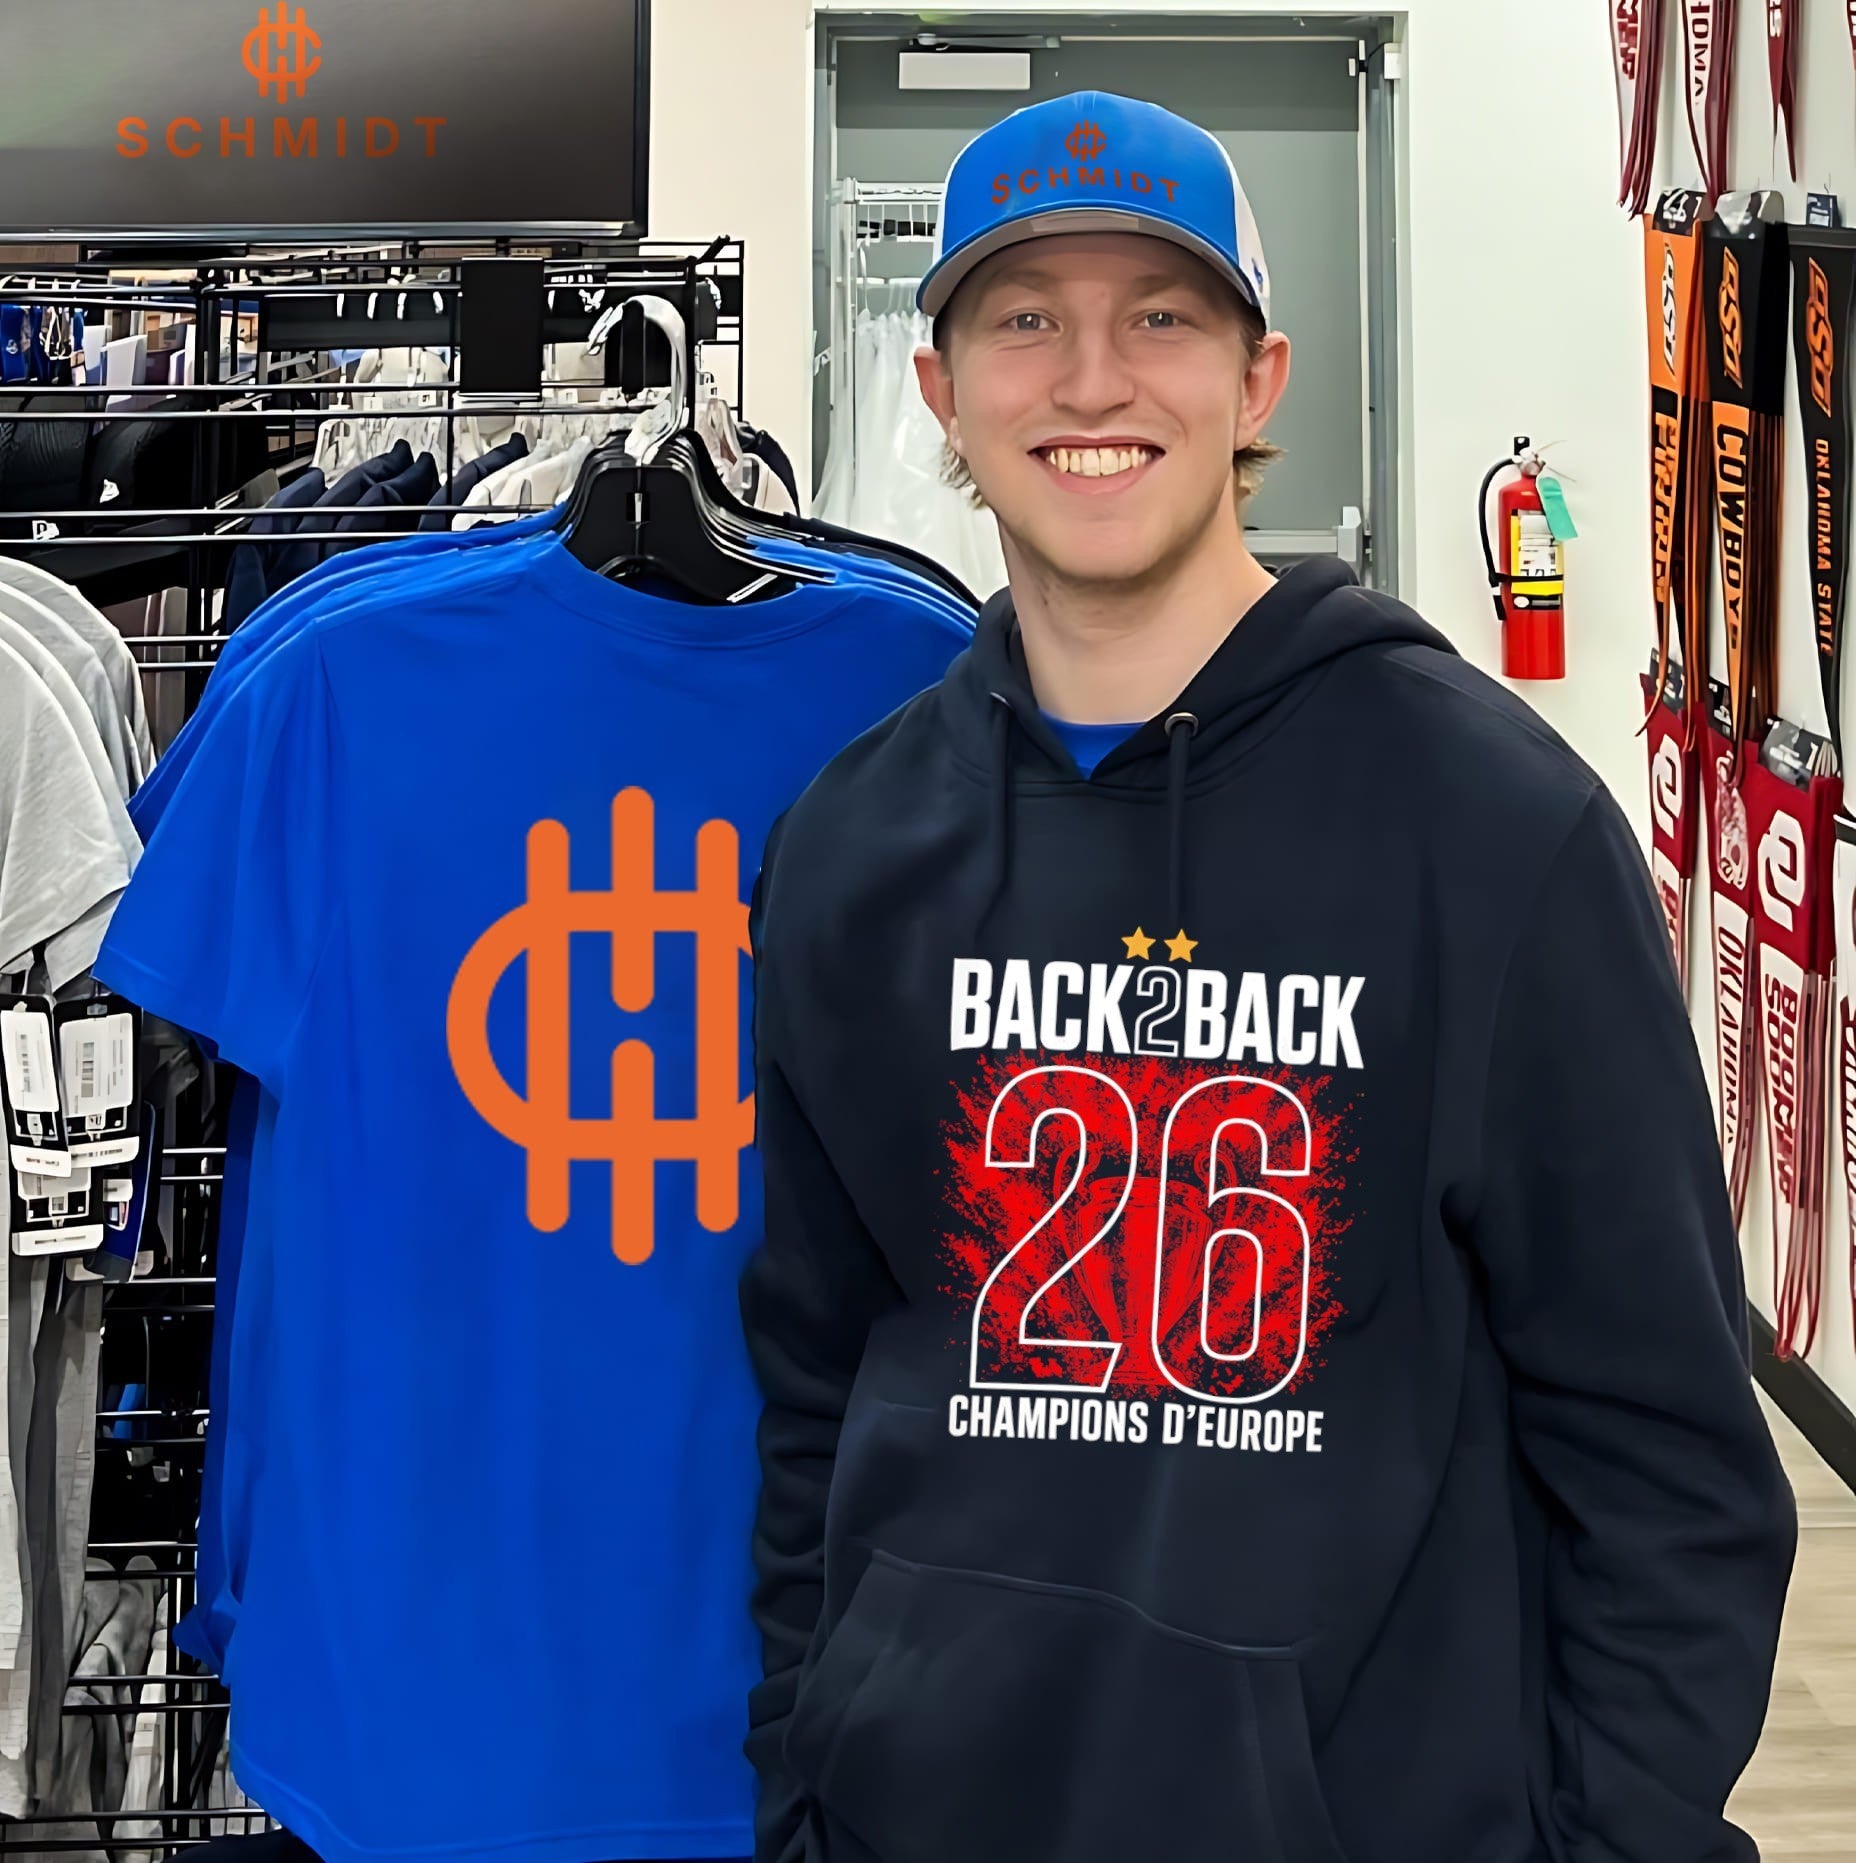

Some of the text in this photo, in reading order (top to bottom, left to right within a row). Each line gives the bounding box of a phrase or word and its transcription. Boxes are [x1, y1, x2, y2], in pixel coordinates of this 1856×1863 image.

[115, 115, 447, 159] SCHMIDT
[991, 166, 1179, 204] SCHMIDT
[1815, 439, 1832, 570] OKLAHOMA
[950, 957, 1366, 1069] BACK2BACK
[1717, 924, 1745, 1144] OKLAHOMA
[970, 1064, 1312, 1404] 26
[948, 1394, 1324, 1452] CHAMPIONS D’EUROPE
